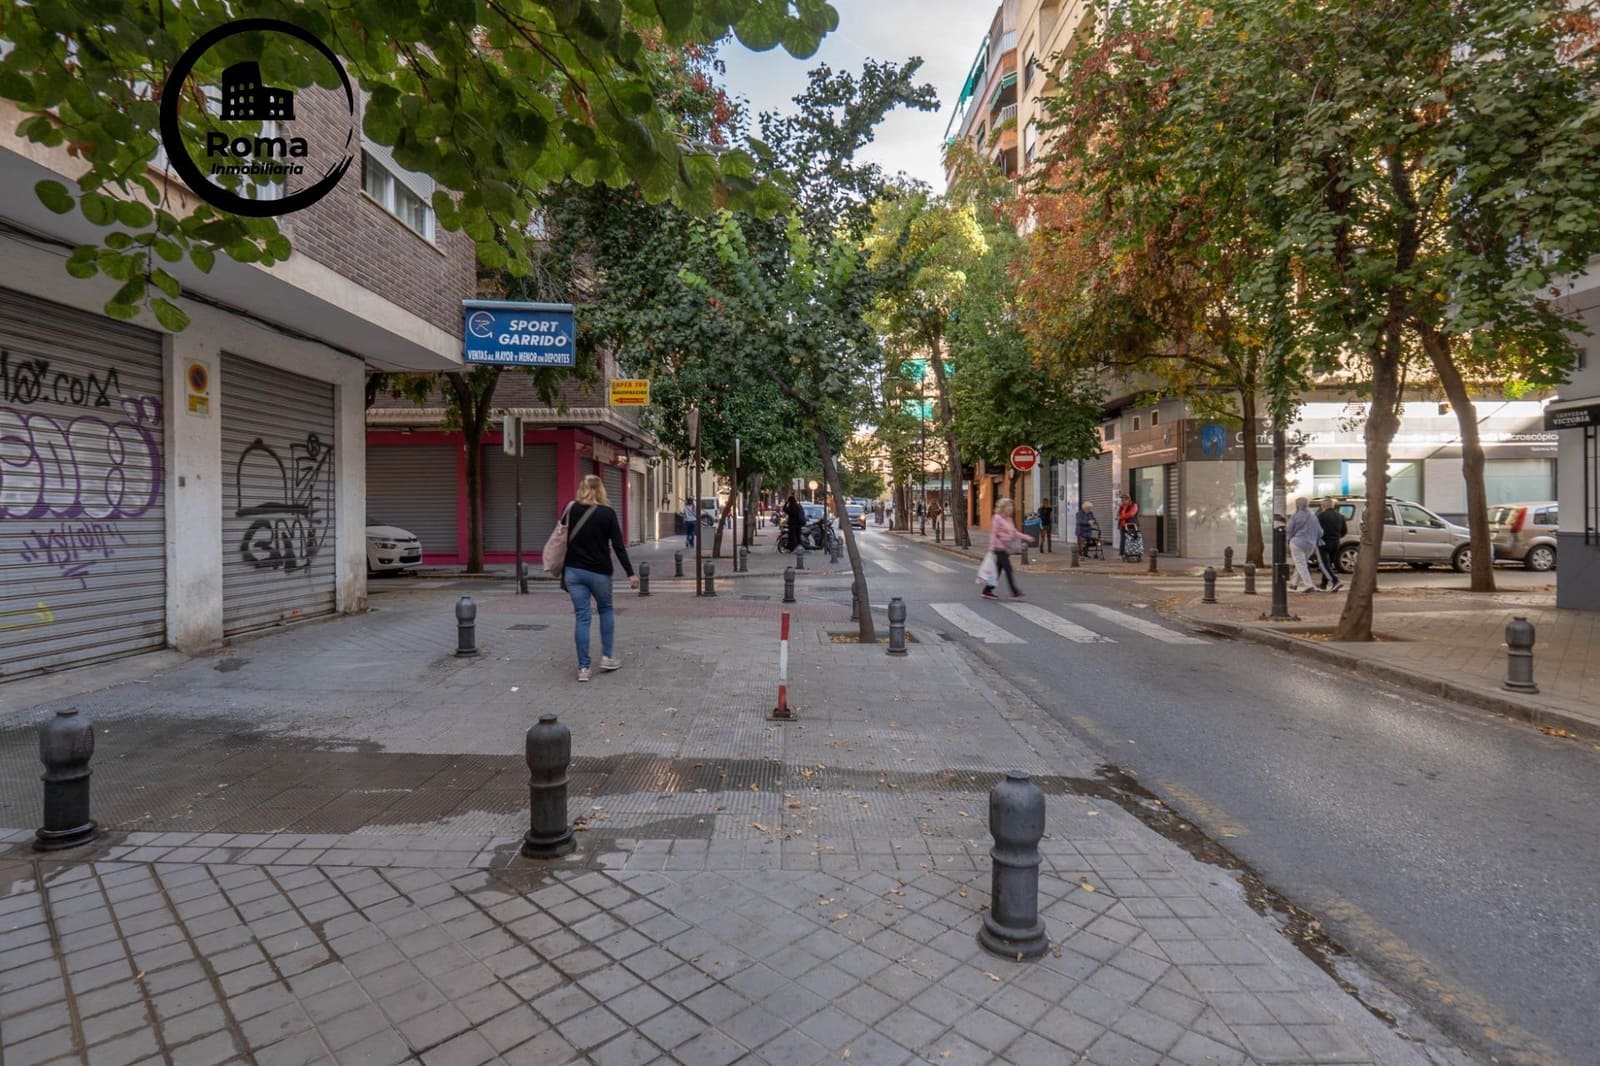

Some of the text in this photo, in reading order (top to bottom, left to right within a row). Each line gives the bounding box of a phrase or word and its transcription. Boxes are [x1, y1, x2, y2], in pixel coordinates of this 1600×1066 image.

[509, 320, 559, 332] SPORT
[498, 334, 568, 347] GARRIDO
[468, 350, 488, 361] VENTAS
[494, 350, 513, 362] MAYOR
[519, 352, 537, 363] MENOR
[544, 353, 570, 364] DEPORTES
[1553, 415, 1590, 425] VICTORIA
